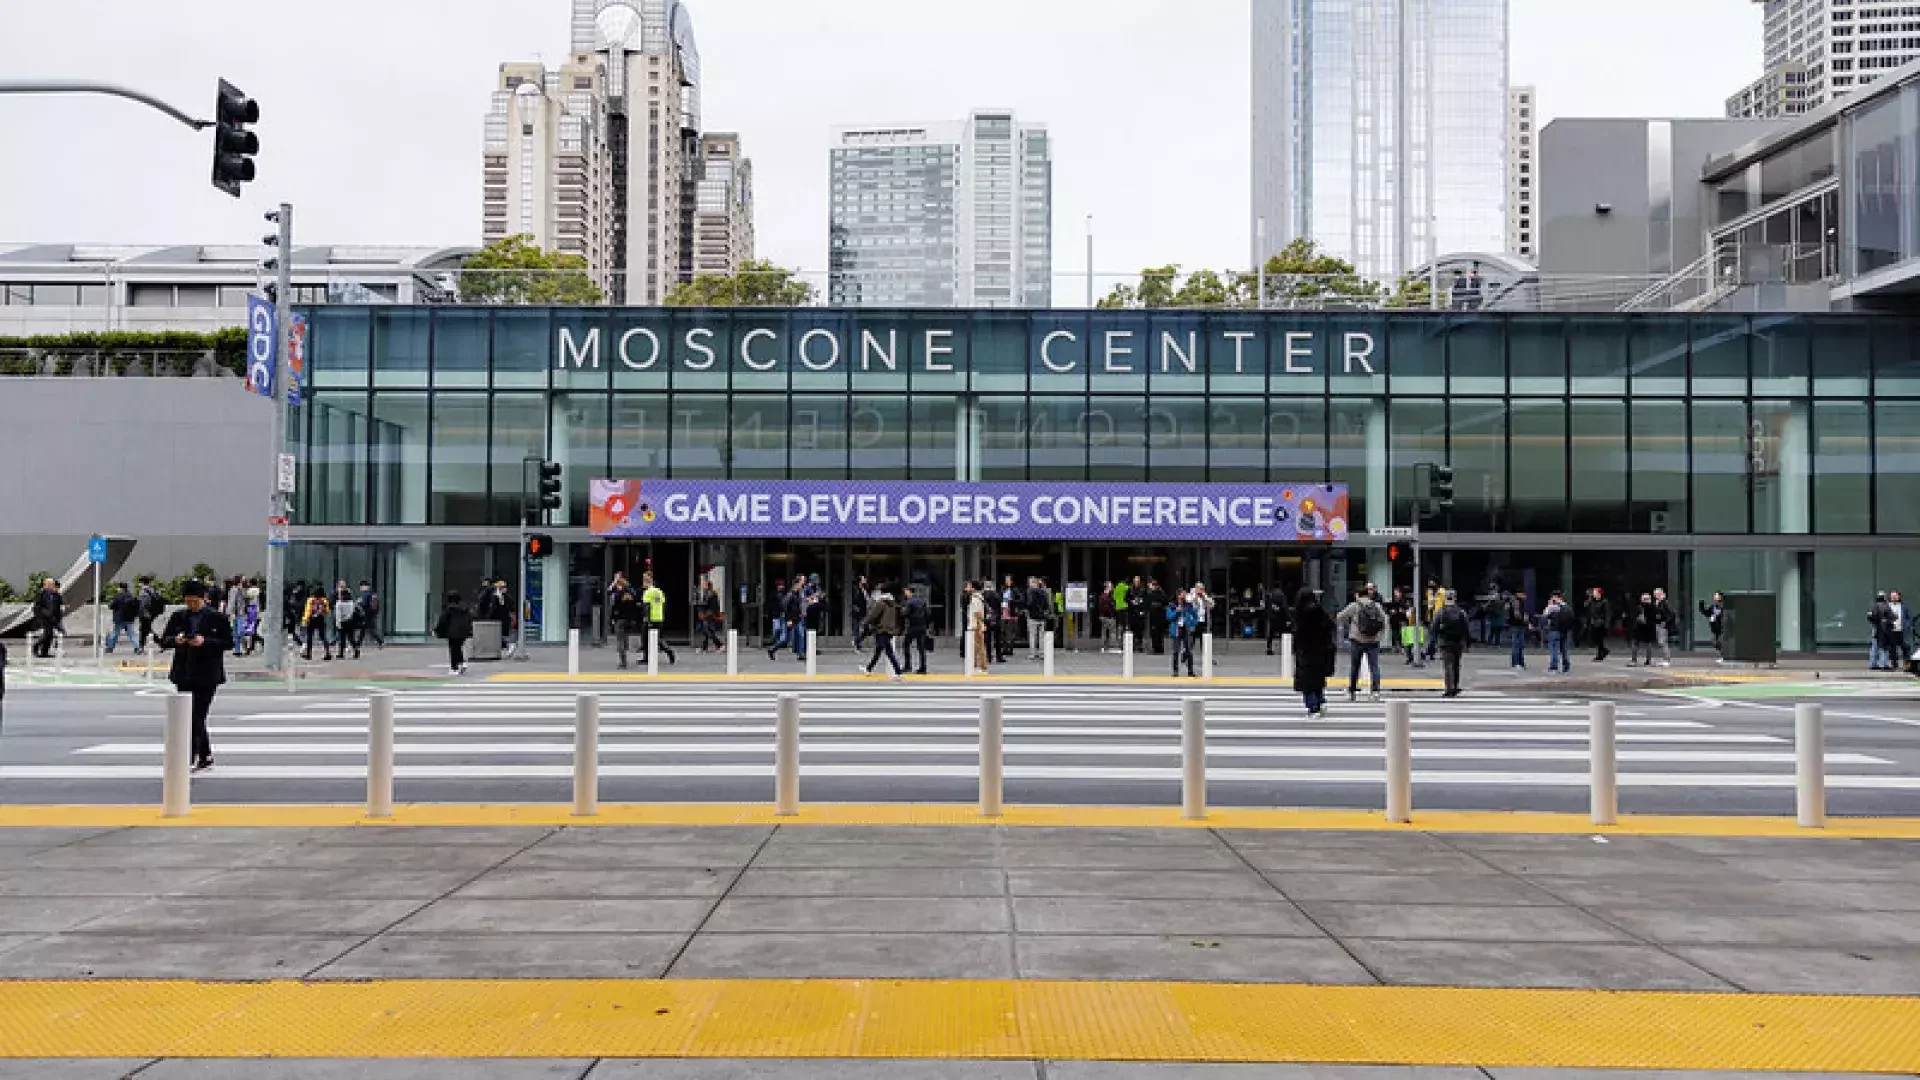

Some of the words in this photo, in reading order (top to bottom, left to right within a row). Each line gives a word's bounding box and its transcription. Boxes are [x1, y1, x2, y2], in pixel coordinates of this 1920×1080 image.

[251, 304, 271, 387] GDC
[554, 327, 954, 374] MOSCONE
[1040, 329, 1376, 374] CENTER
[663, 493, 772, 524] GAME
[781, 493, 1021, 526] DEVELOPERS
[1030, 495, 1274, 527] CONFERENCE
